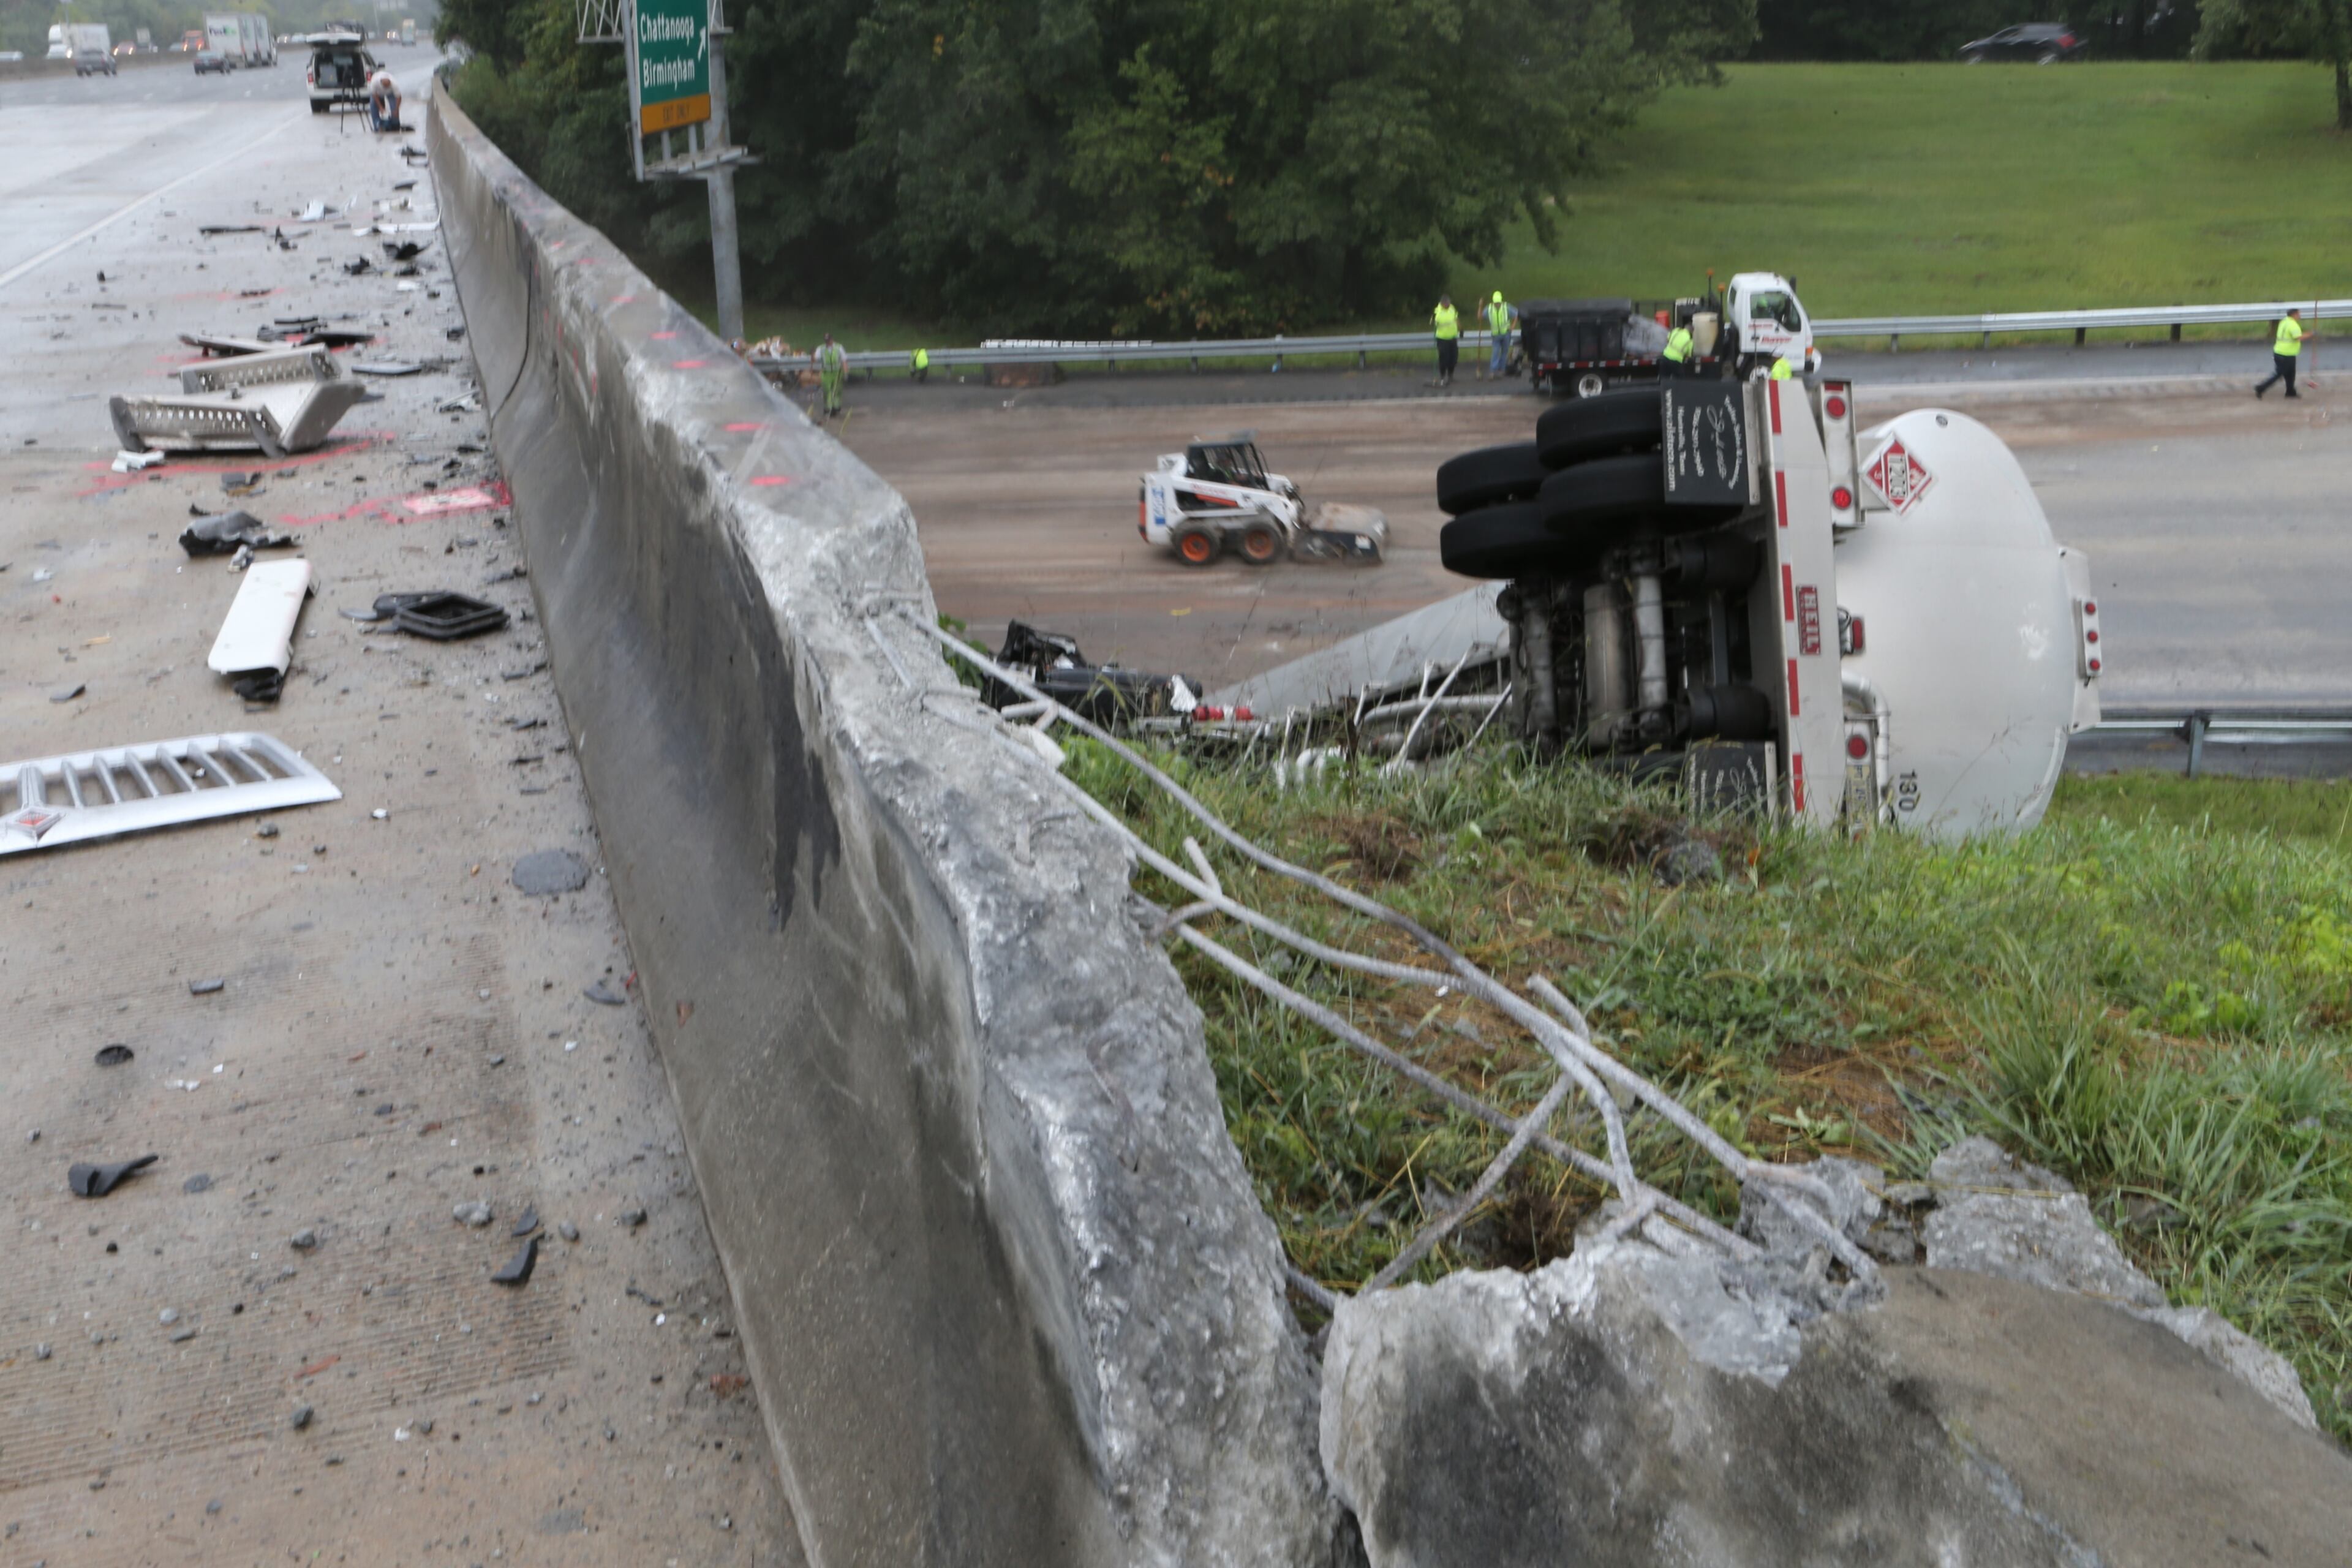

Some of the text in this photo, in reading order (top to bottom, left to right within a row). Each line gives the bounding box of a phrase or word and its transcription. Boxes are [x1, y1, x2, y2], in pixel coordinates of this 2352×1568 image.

[640, 12, 695, 46] Chattanooga
[643, 55, 695, 90] Birmingham
[1888, 455, 1907, 498] 1203
[1804, 593, 1819, 649] HEIL
[1899, 769, 1918, 812] 130
